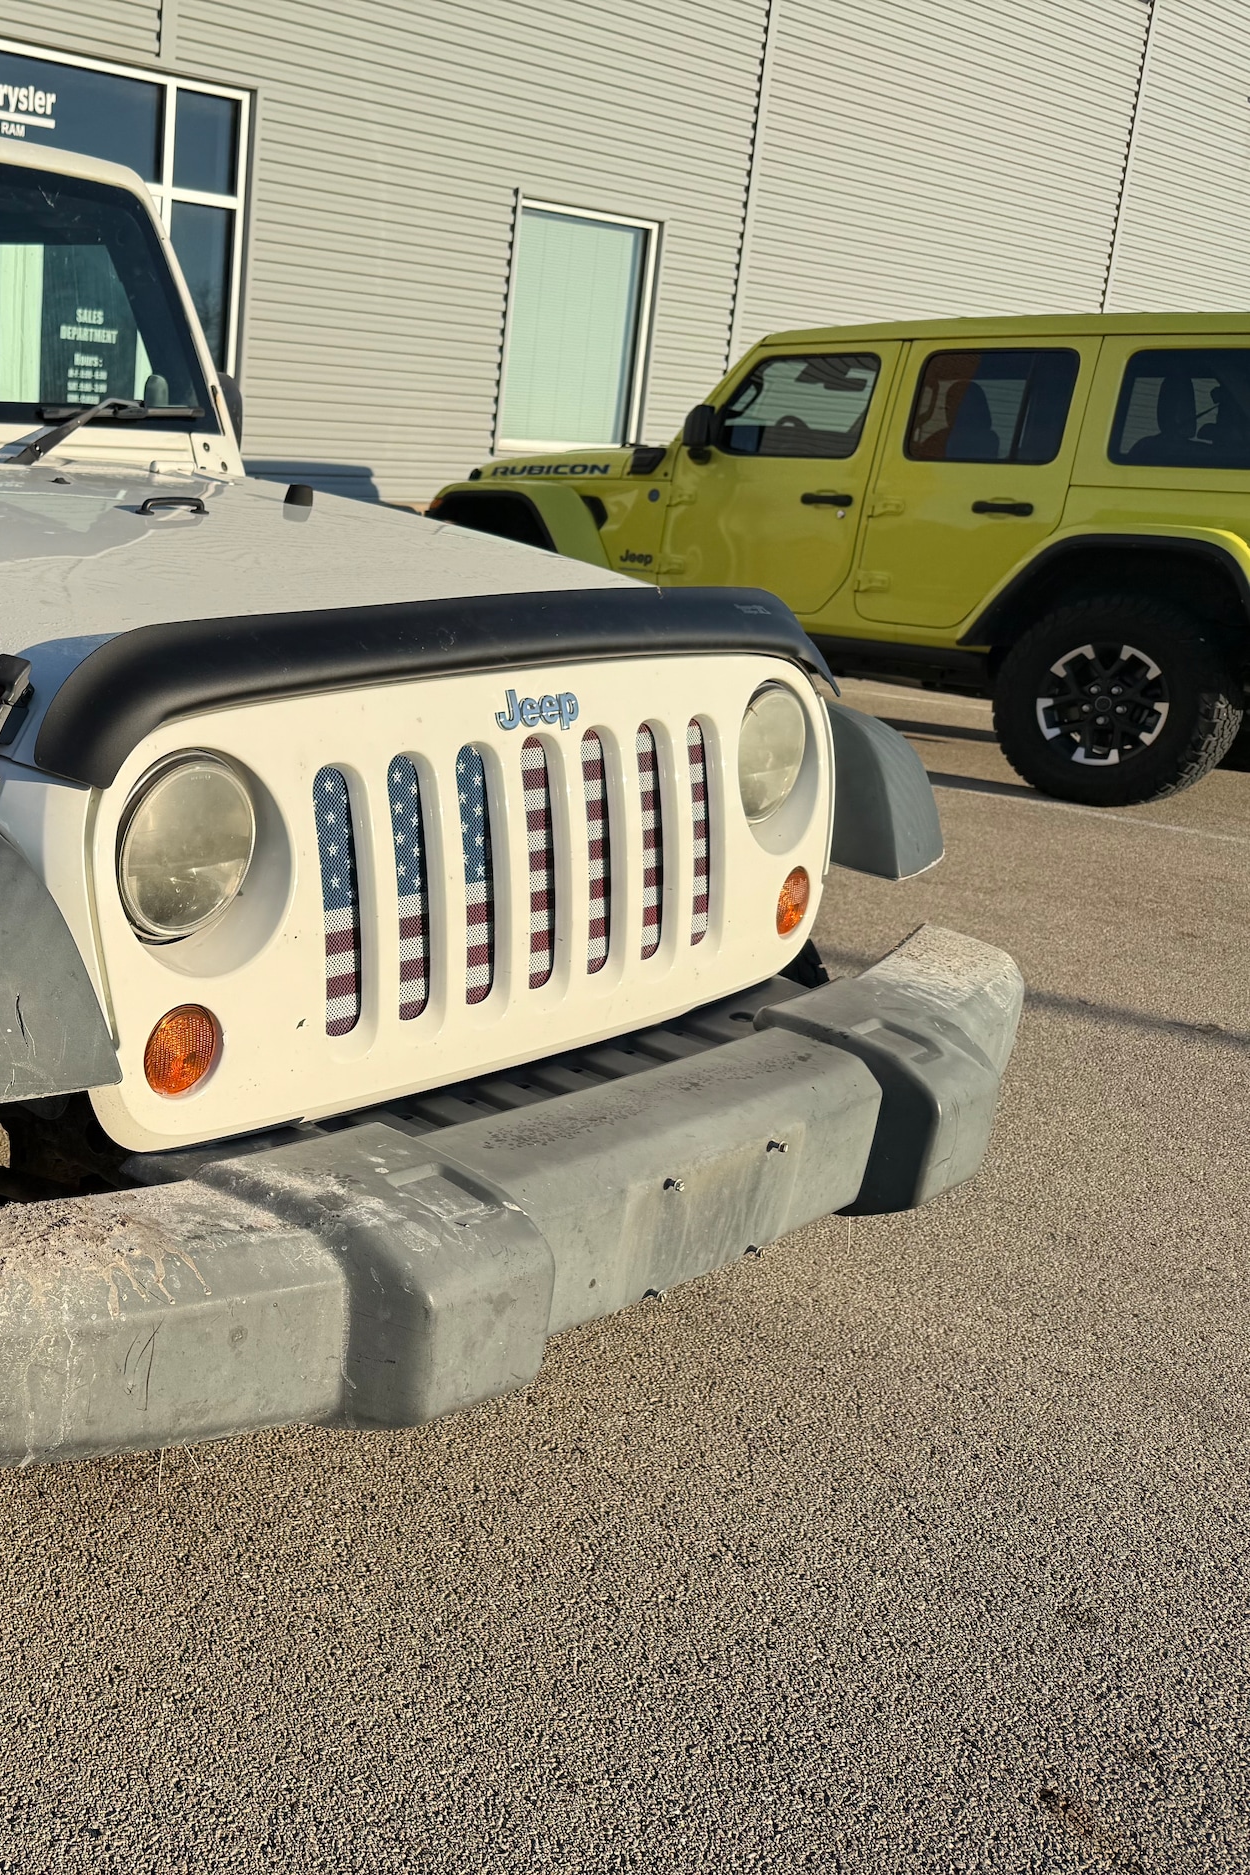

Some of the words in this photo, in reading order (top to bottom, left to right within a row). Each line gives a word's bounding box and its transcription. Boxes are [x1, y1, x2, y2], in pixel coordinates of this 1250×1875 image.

[1, 122, 26, 138] RAM
[76, 308, 104, 325] SALES
[59, 324, 118, 344] DEPARTMENT
[491, 464, 611, 477] RUBICON
[619, 549, 654, 566] Jeep
[495, 689, 580, 731] Jeep
